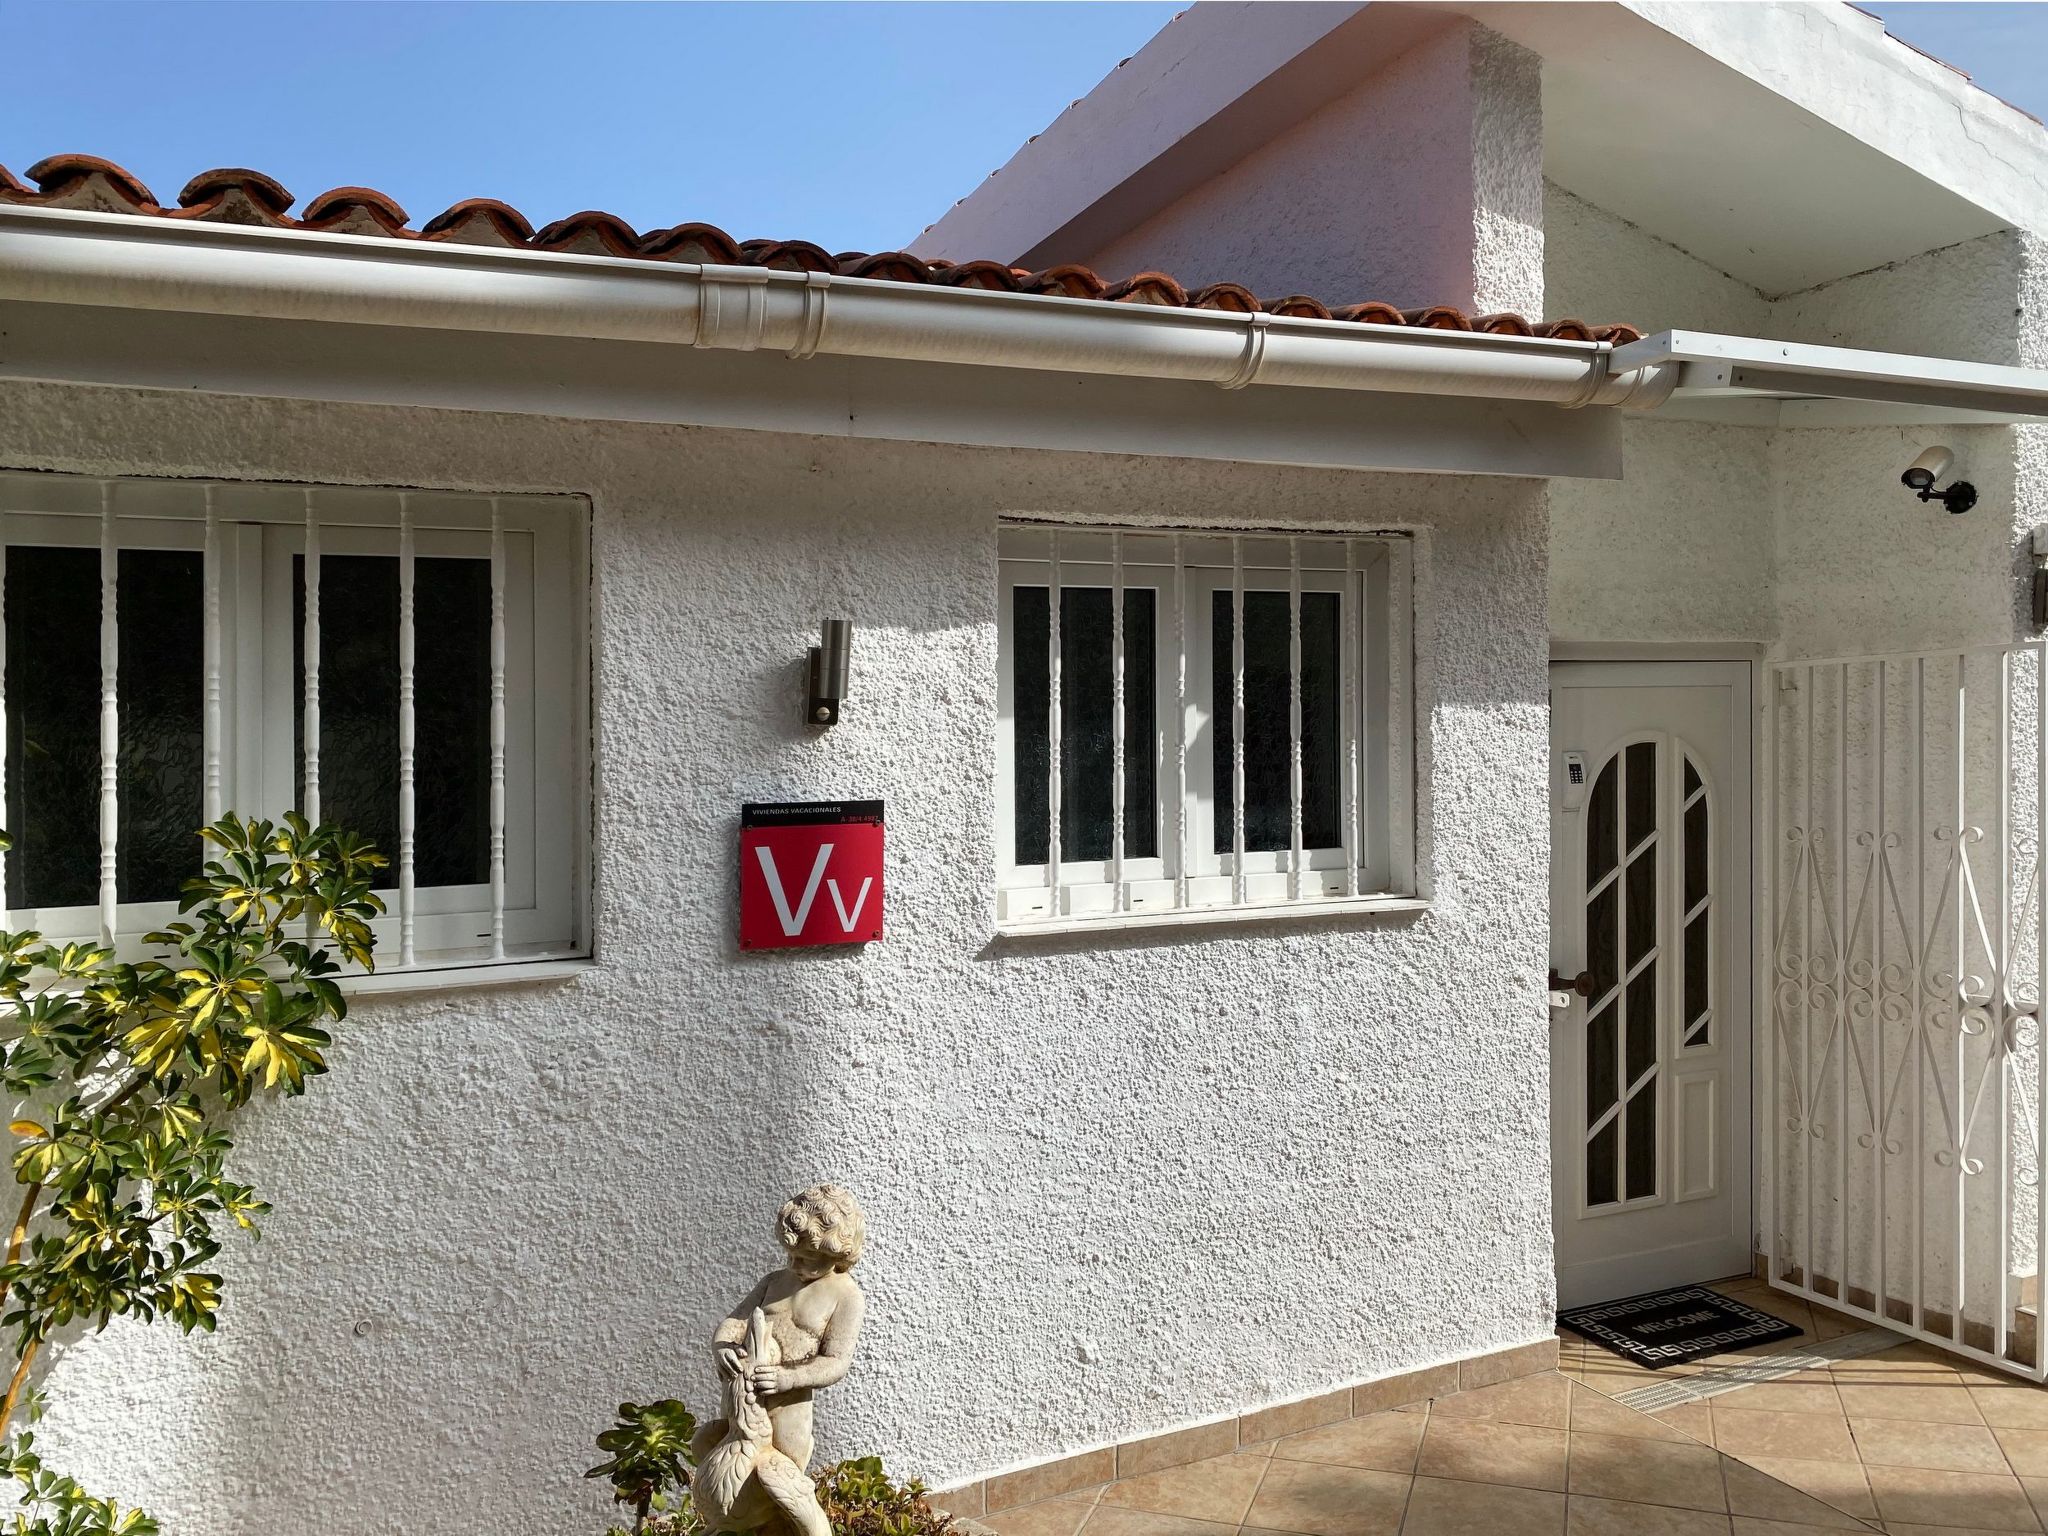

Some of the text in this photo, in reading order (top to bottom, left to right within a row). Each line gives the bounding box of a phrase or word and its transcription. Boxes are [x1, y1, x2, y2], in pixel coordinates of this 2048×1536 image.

[752, 806, 842, 816] VIVIENDAS VACACIONALES
[1631, 1310, 1721, 1334] WELCOME
